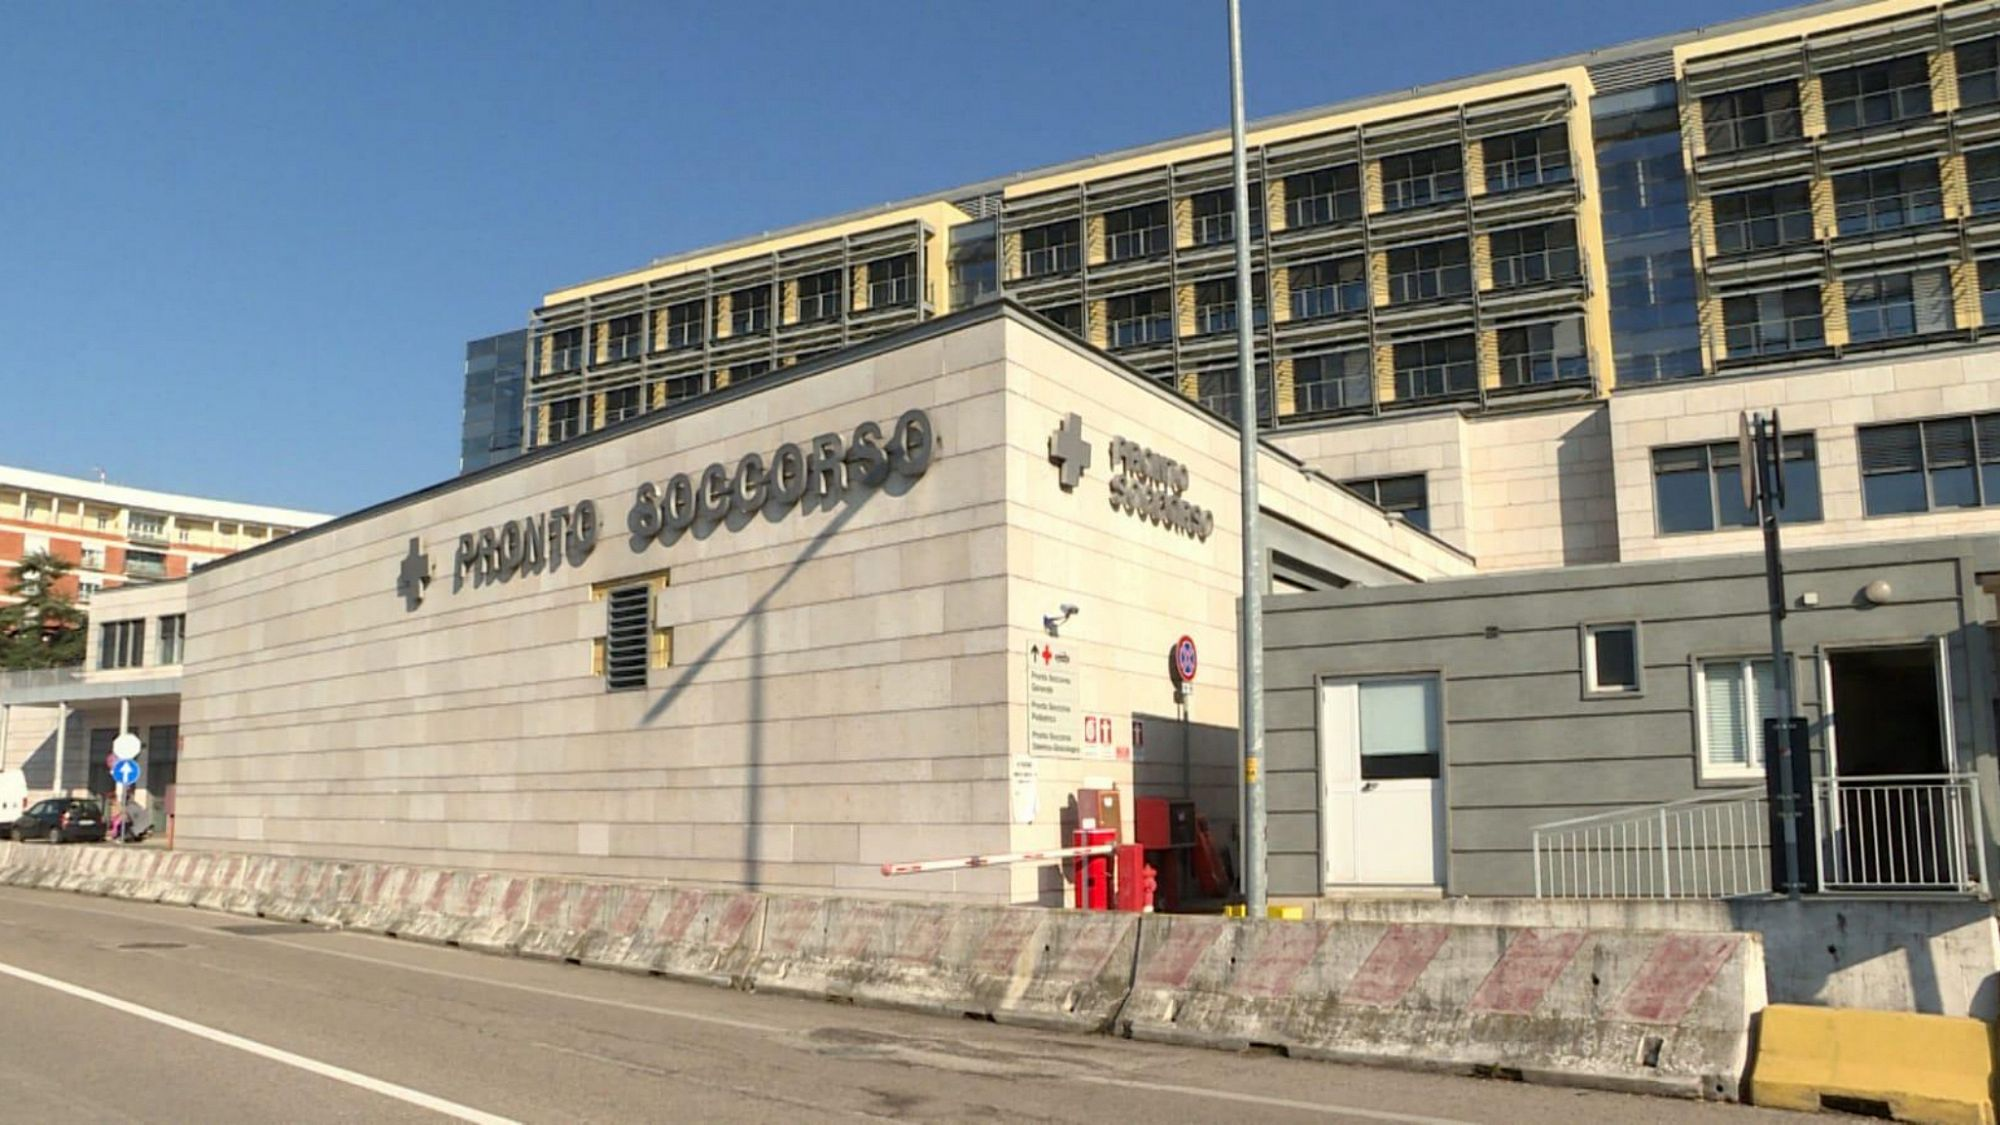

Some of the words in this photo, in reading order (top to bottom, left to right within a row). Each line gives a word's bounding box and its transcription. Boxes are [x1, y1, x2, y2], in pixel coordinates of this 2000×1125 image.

[455, 500, 596, 579] PRONTO
[633, 409, 932, 541] SOCCORSO
[1110, 435, 1189, 492] PRONTO
[1109, 474, 1213, 537] SOCCORSO
